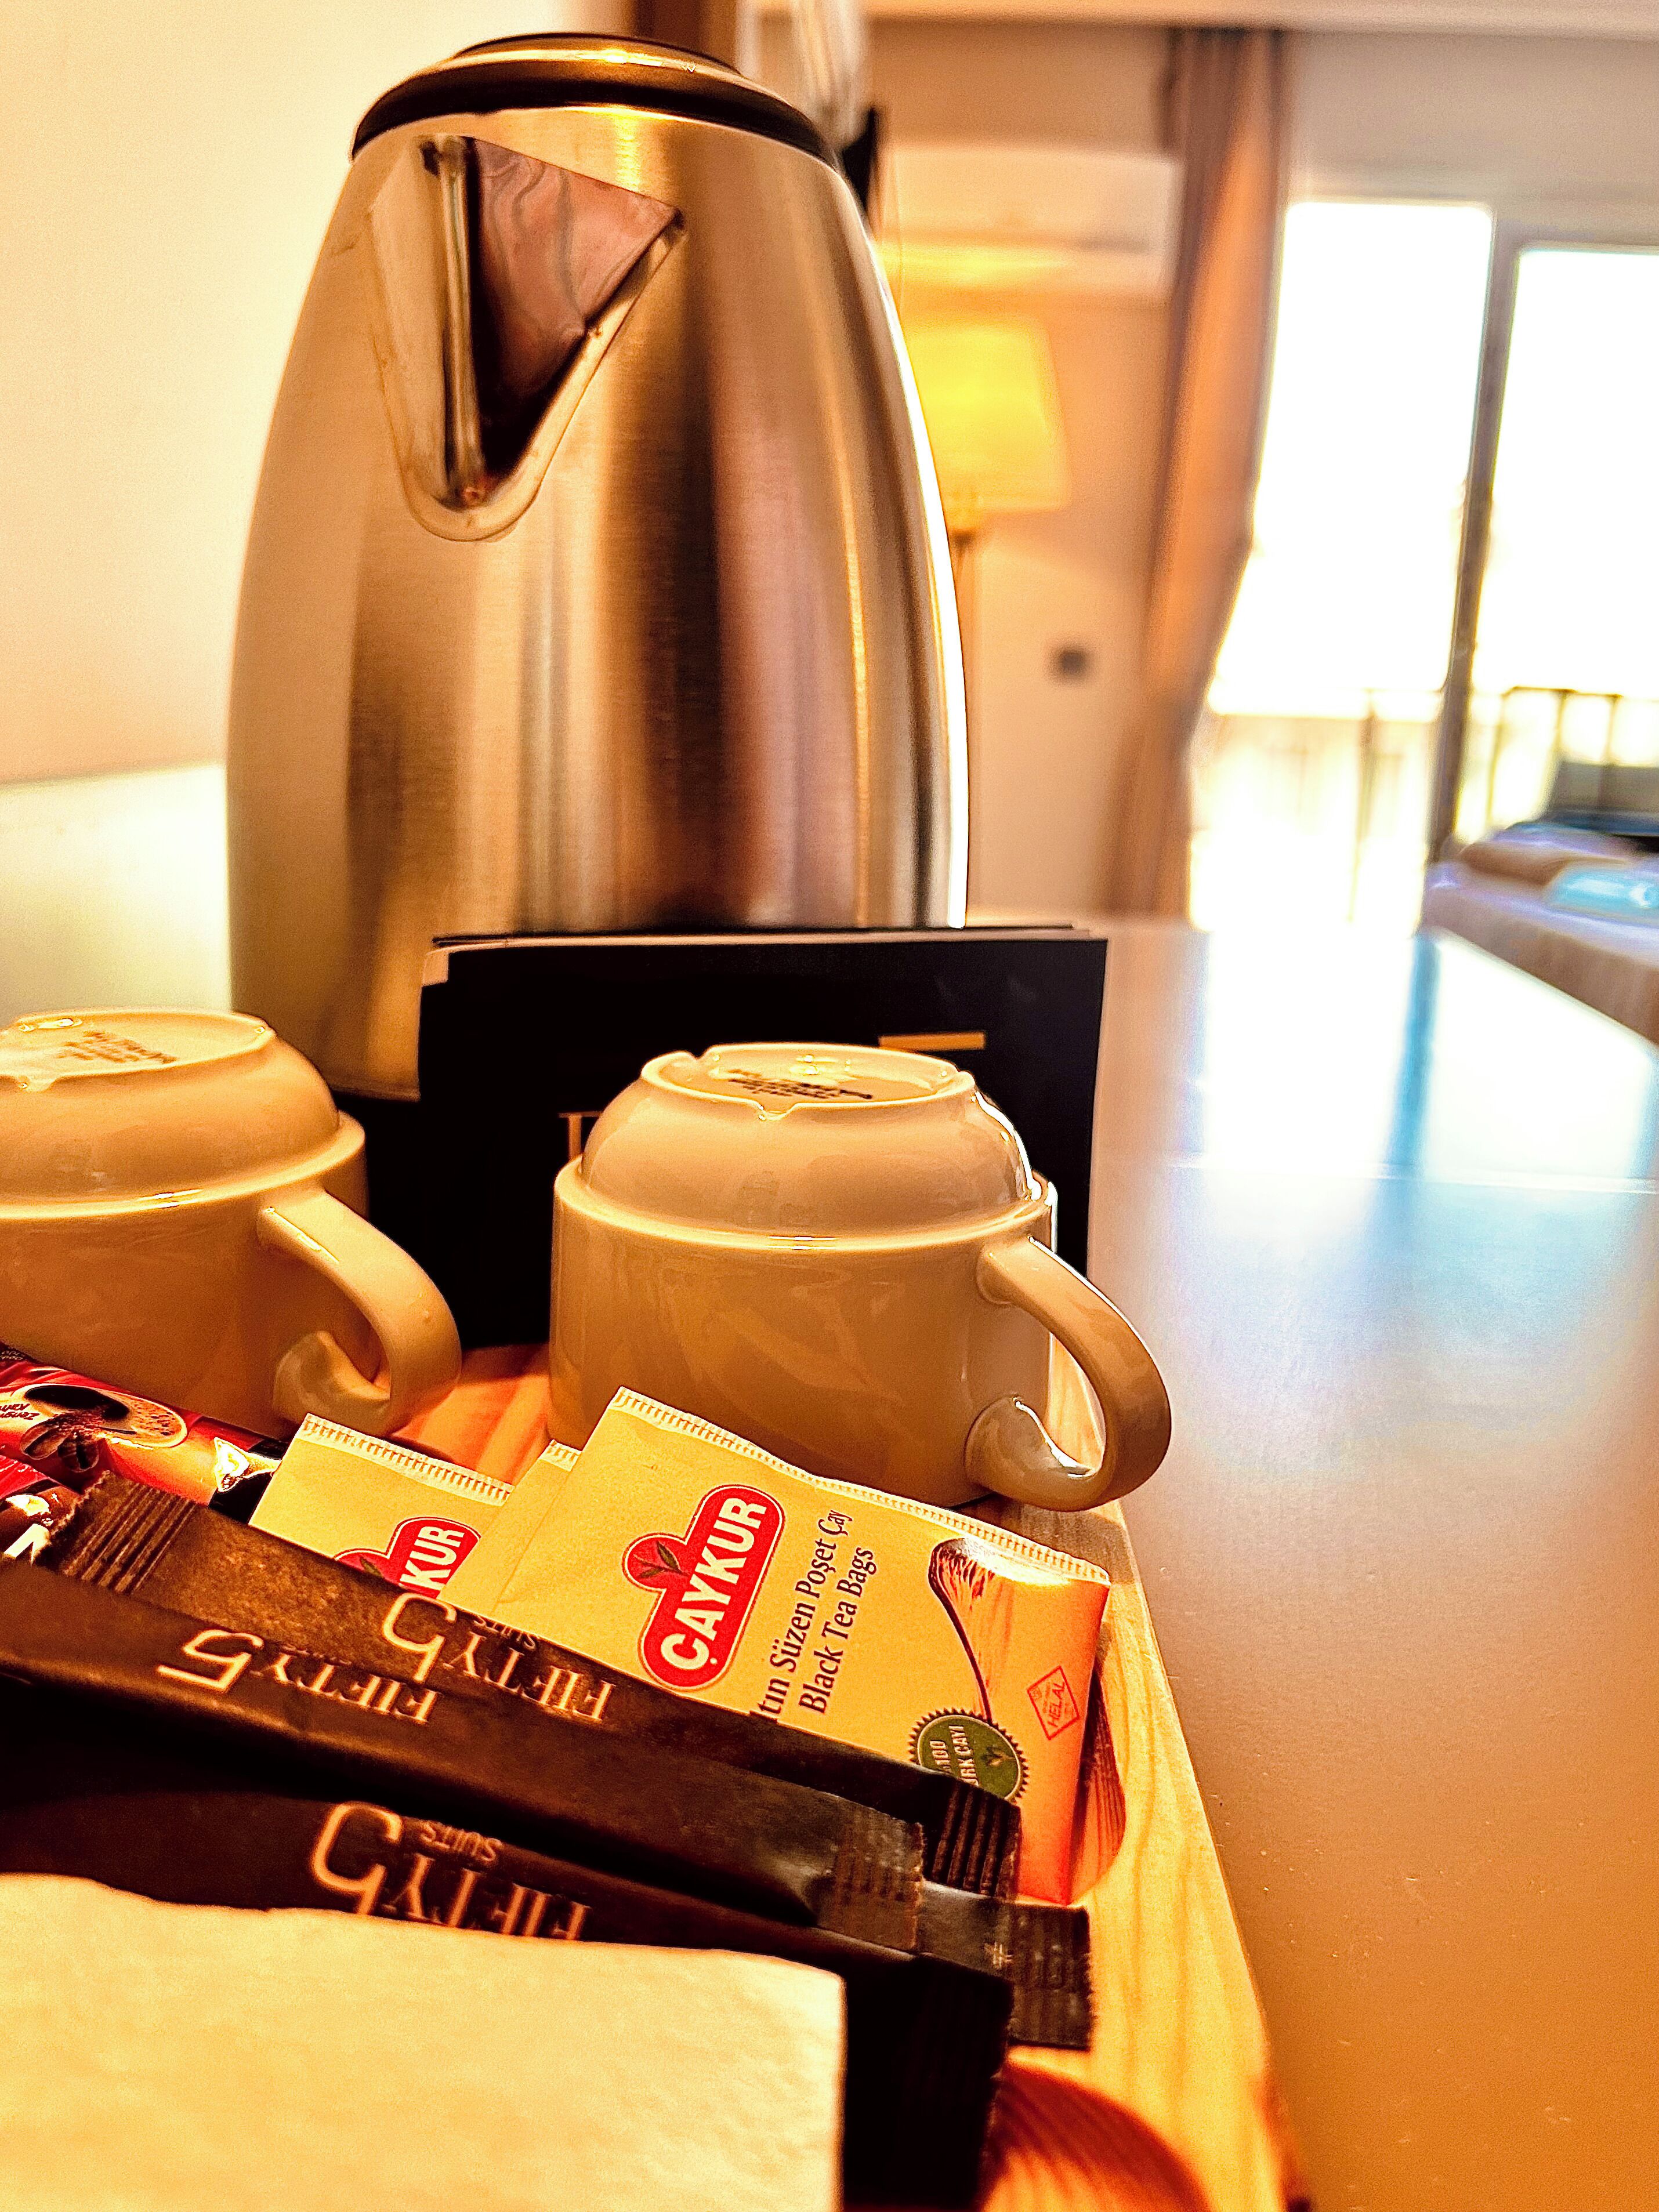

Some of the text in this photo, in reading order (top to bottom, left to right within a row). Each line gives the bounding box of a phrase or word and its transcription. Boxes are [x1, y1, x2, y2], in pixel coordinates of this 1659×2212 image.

[399, 1525, 465, 1590] KUR
[749, 1510, 853, 1724] ltın Süzen Poşet Çay
[798, 1547, 877, 1714] Black Tea Bags
[1046, 1681, 1066, 1728] HELAL
[929, 1740, 952, 1772] 100
[419, 1819, 502, 1864] SUITS
